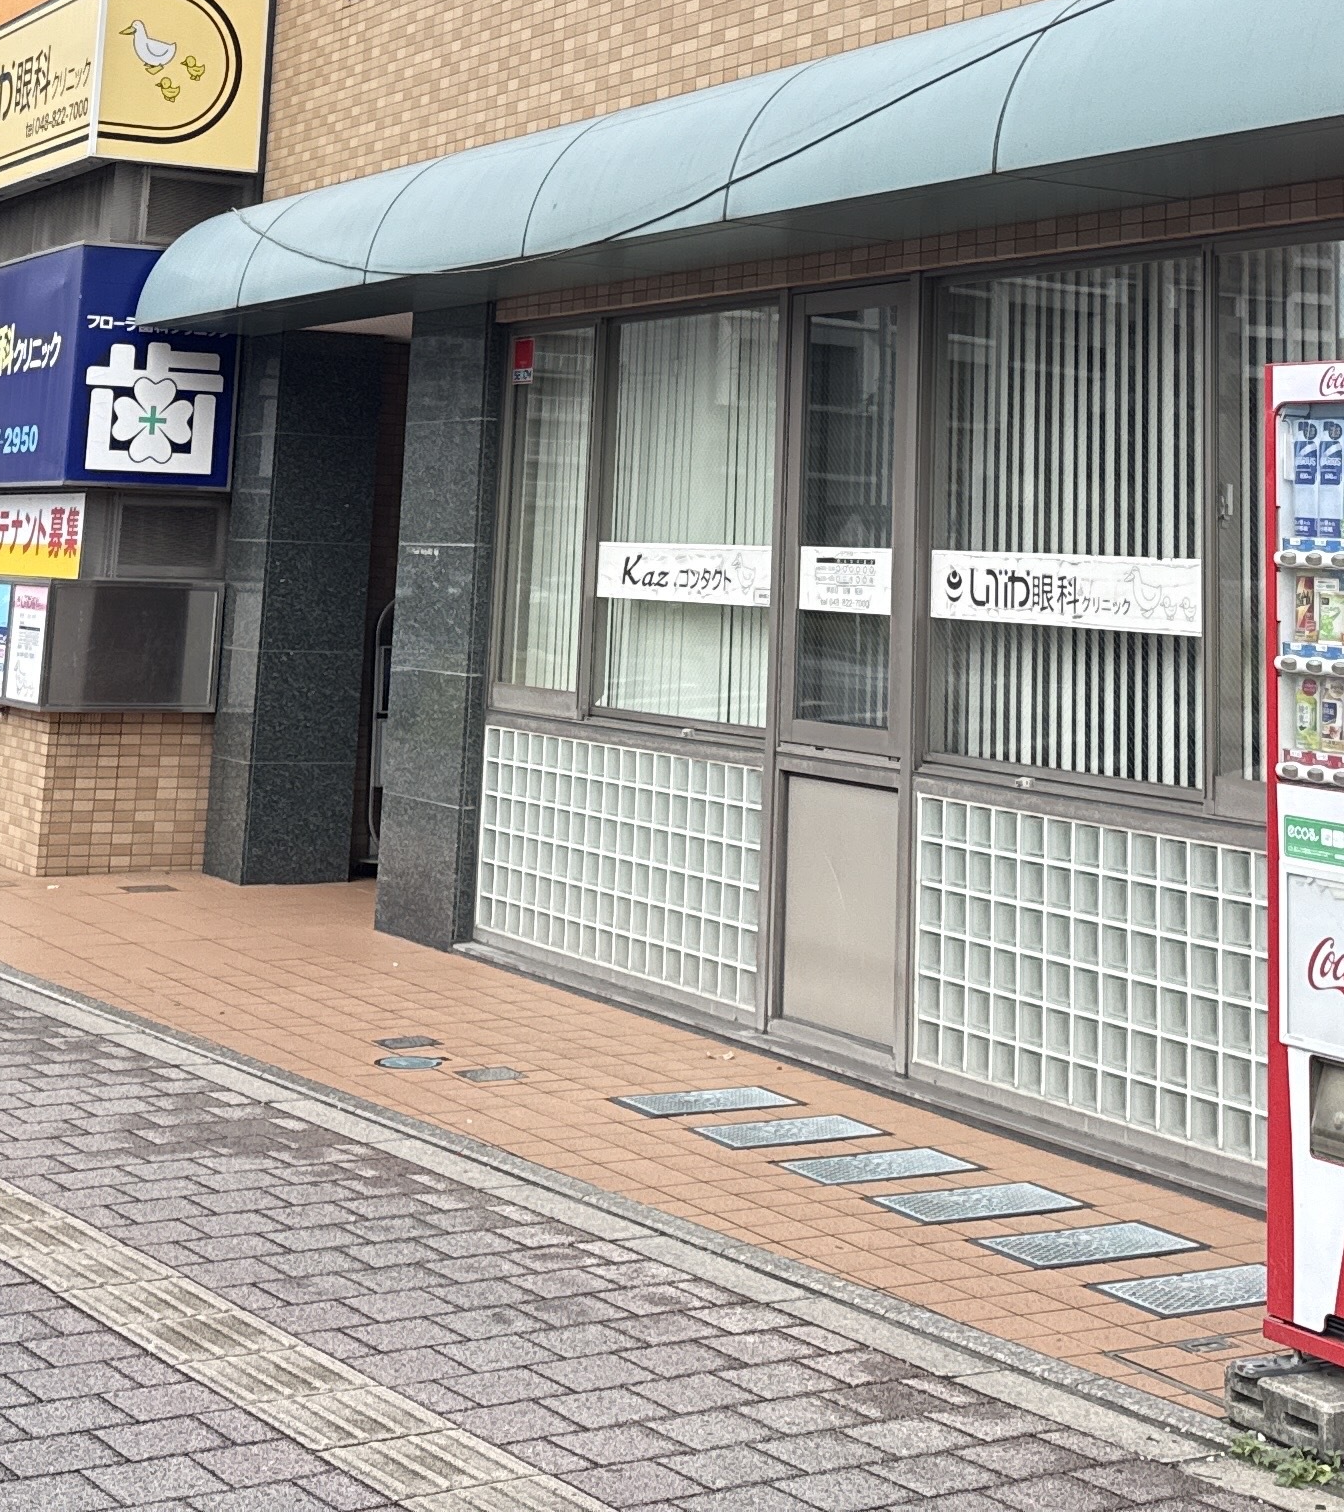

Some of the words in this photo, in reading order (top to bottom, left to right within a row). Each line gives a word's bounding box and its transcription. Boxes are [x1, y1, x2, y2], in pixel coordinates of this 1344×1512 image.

[621, 553, 670, 588] Kaz
[677, 567, 732, 591] コンタクト
